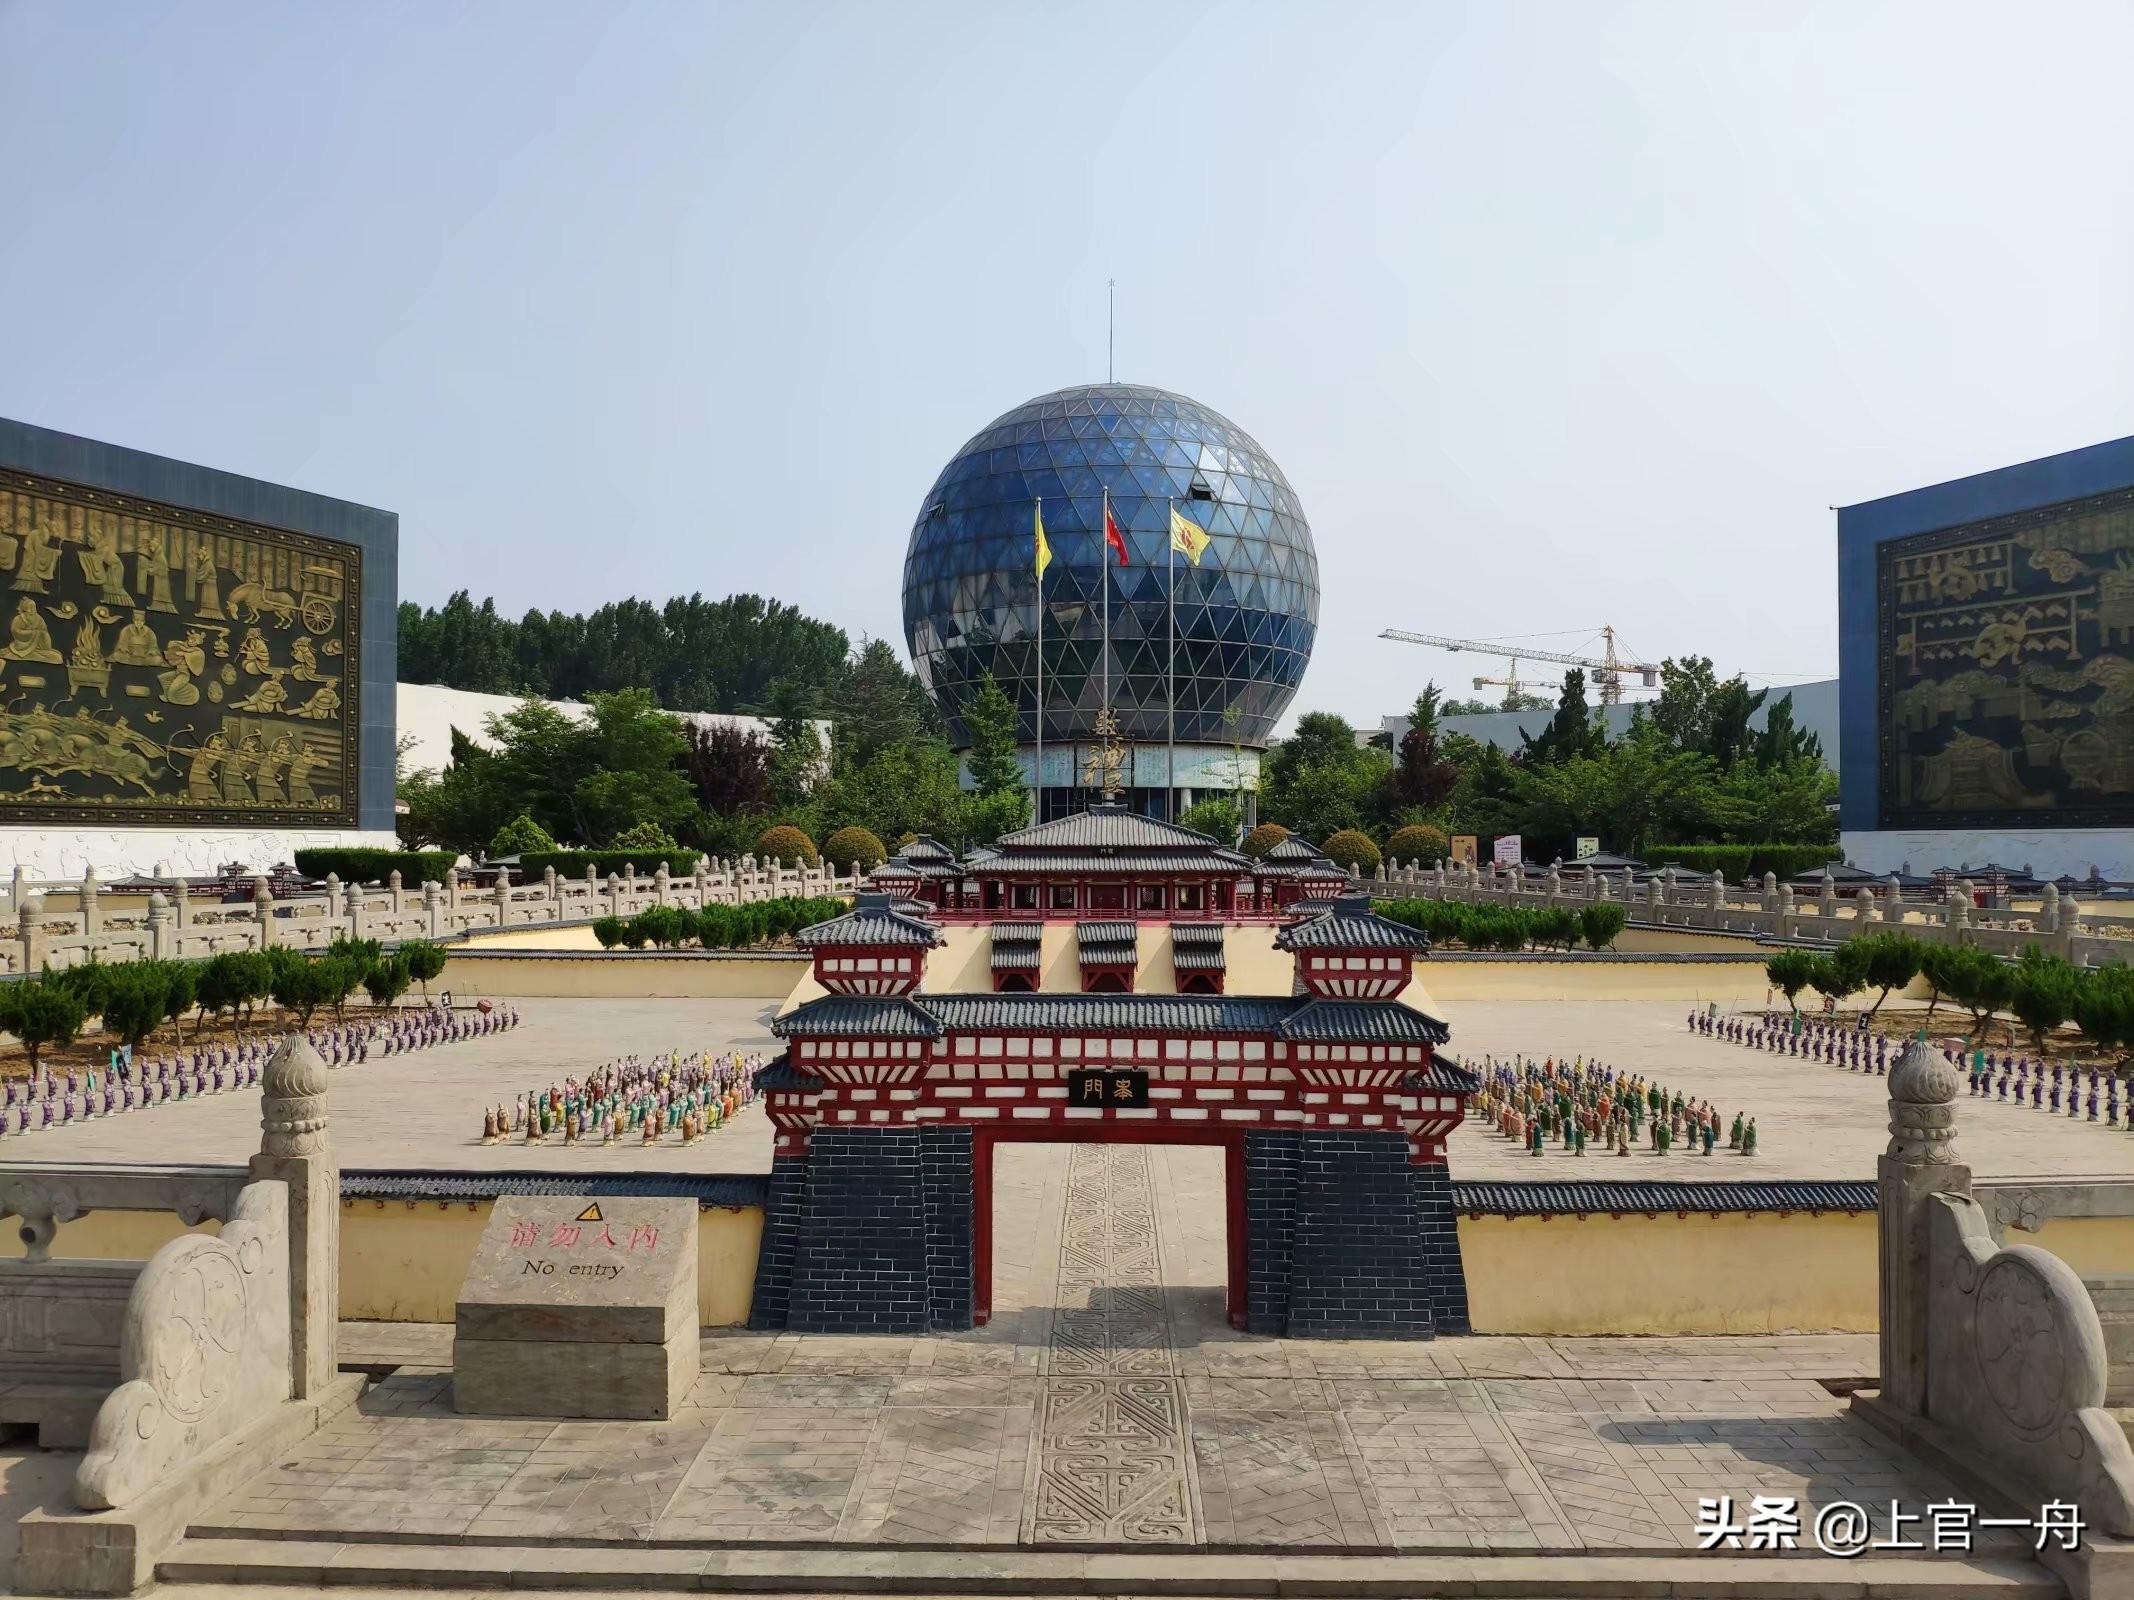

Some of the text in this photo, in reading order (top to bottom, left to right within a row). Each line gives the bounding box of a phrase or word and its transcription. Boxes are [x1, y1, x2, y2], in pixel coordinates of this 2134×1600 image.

[510, 1222, 660, 1249] 请勿入内
[521, 1260, 625, 1280] No entry
